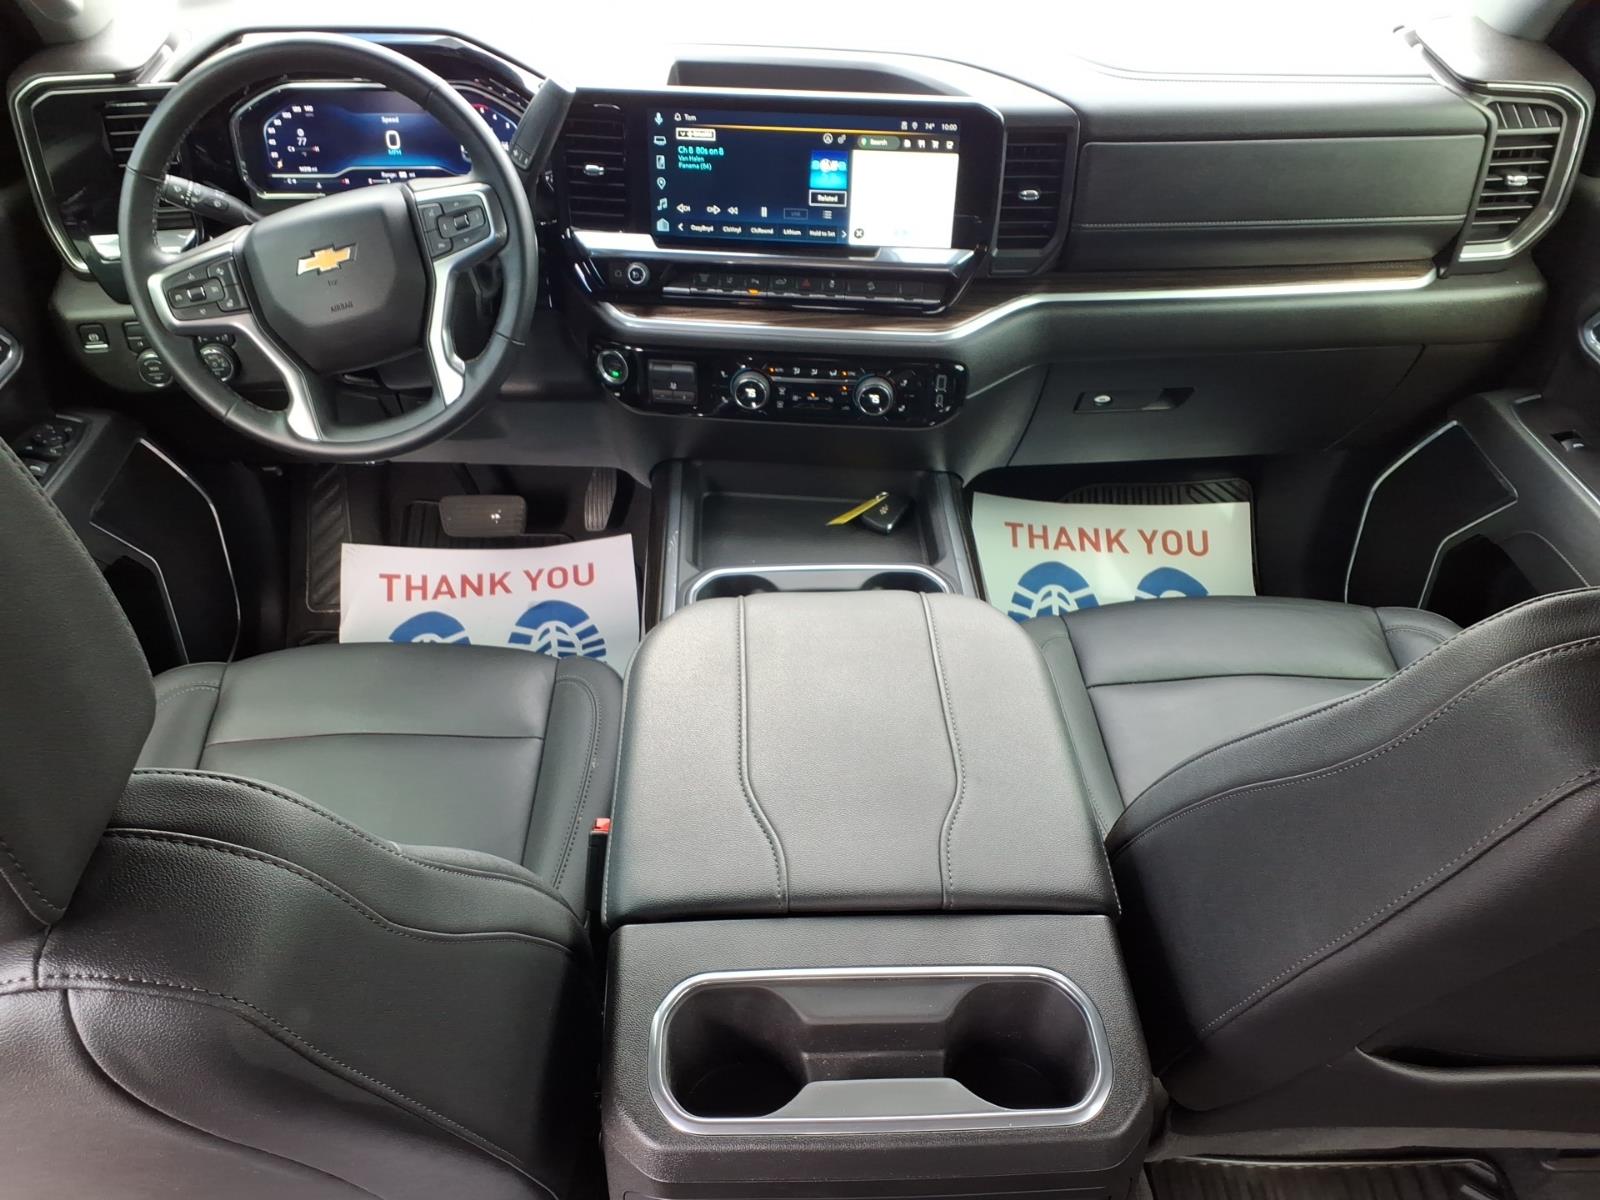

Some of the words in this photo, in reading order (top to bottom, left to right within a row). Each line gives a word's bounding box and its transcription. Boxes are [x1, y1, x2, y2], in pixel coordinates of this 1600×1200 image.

[381, 116, 400, 124] Speed
[684, 113, 697, 121] Tom
[941, 123, 958, 131] 10:00
[385, 130, 401, 150] 0
[678, 146, 688, 154] Ch
[695, 146, 708, 155] 80s
[718, 147, 724, 156] 8
[678, 162, 700, 170] Panama
[817, 194, 839, 202] Related
[1004, 521, 1130, 554] THANK
[1137, 529, 1210, 557] YOU
[379, 571, 512, 602] THANK
[523, 562, 596, 592] YOU
